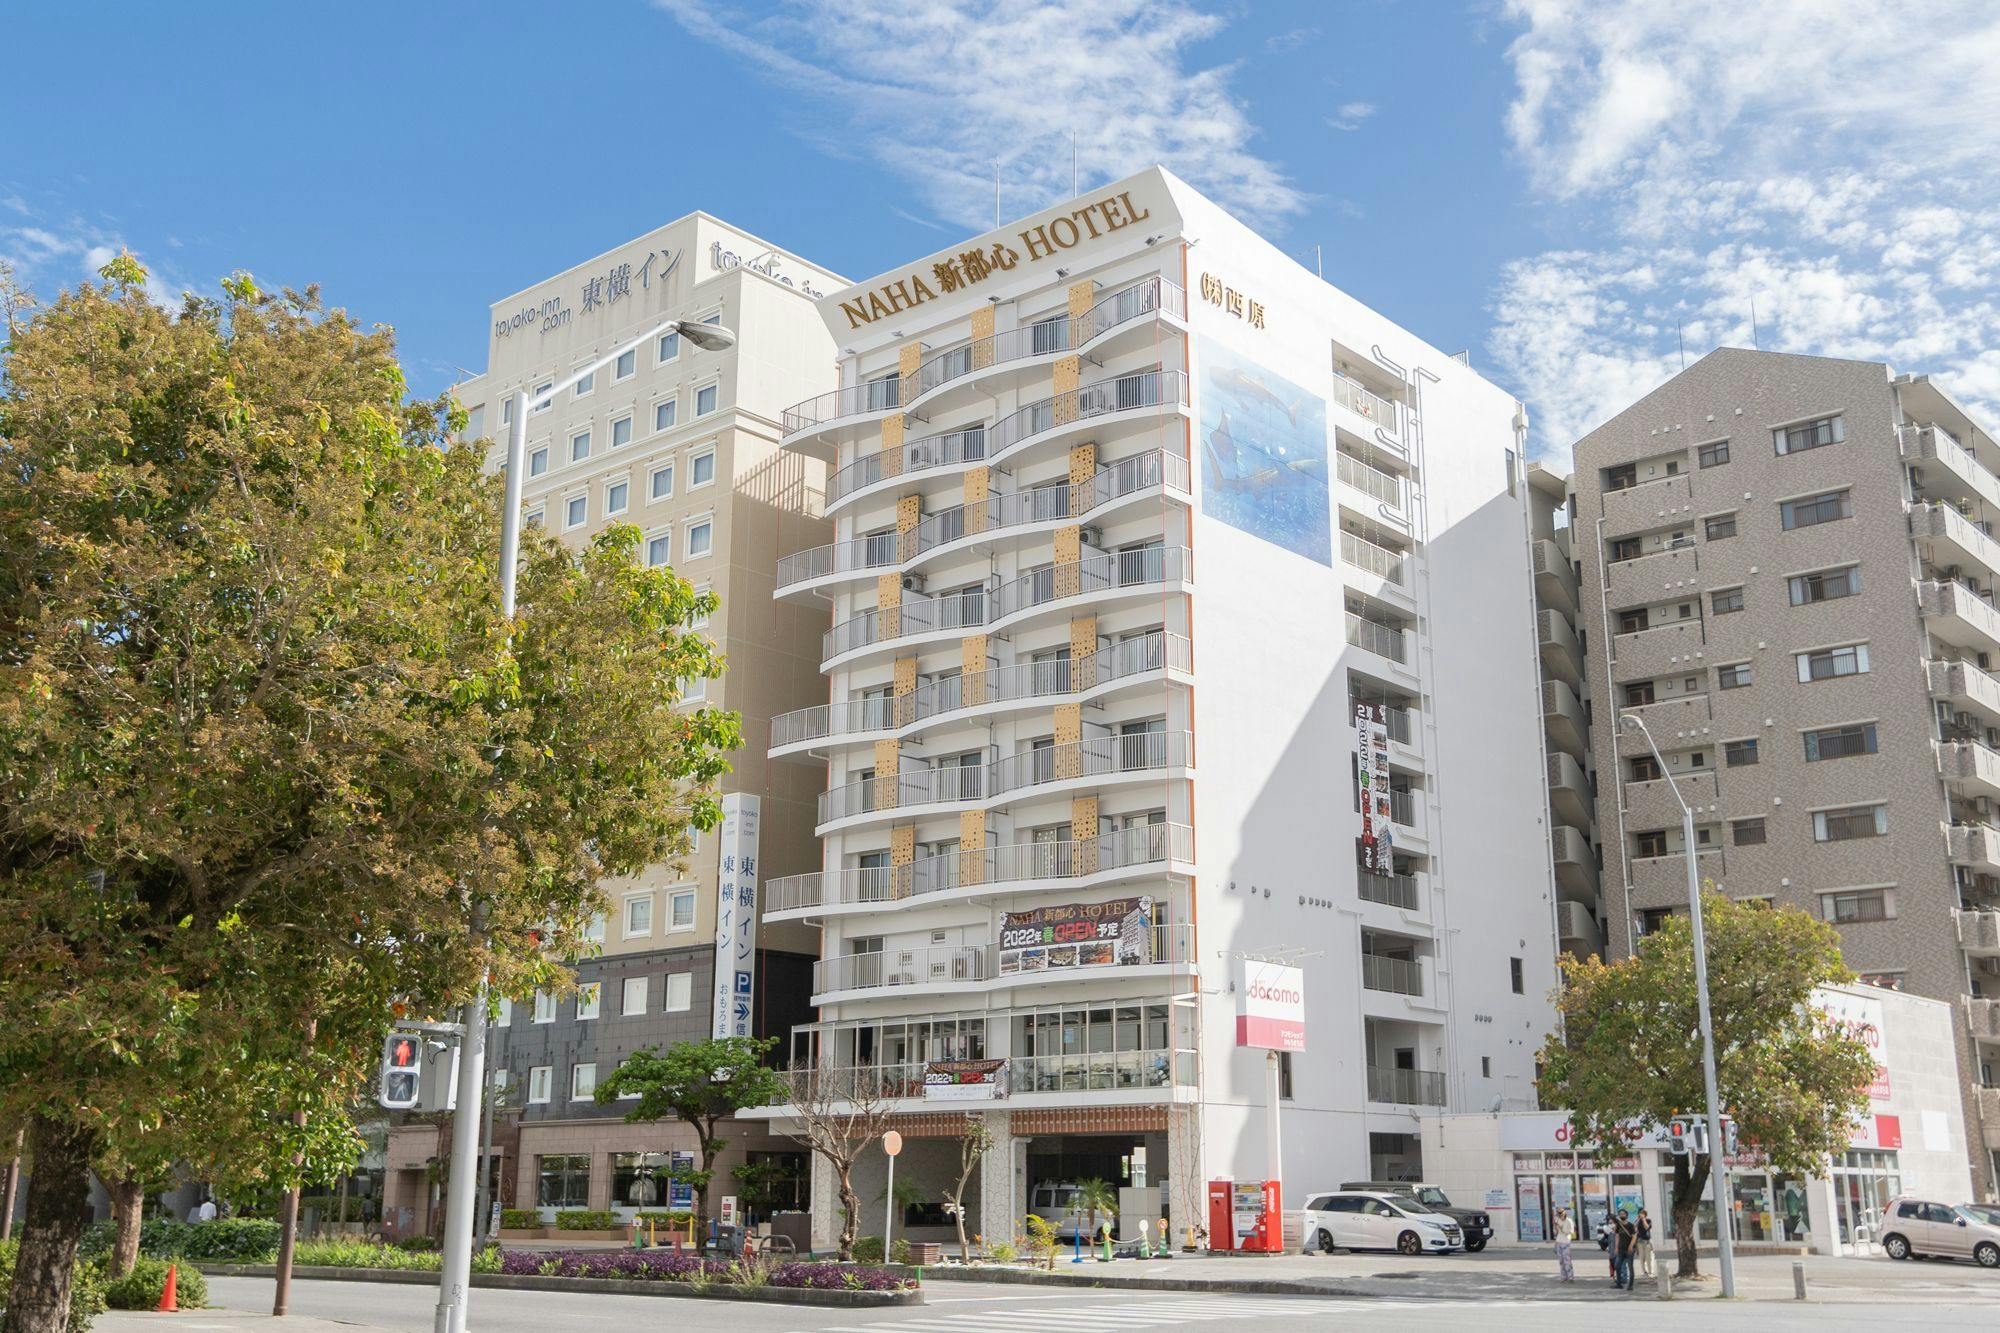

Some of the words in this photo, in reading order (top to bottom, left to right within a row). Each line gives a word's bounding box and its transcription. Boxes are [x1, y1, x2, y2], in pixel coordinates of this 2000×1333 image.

[580, 247, 685, 315] 東横イン
[838, 274, 938, 330] NAHA
[932, 243, 1019, 294] 新都心
[1018, 191, 1149, 262] HOTEL
[495, 296, 561, 338] toyoko-inn
[721, 856, 735, 949] 東横イン
[738, 857, 755, 960] 東横イン
[1080, 901, 1130, 918] HOTEL
[737, 973, 749, 993] P
[1249, 979, 1300, 1004] docomo
